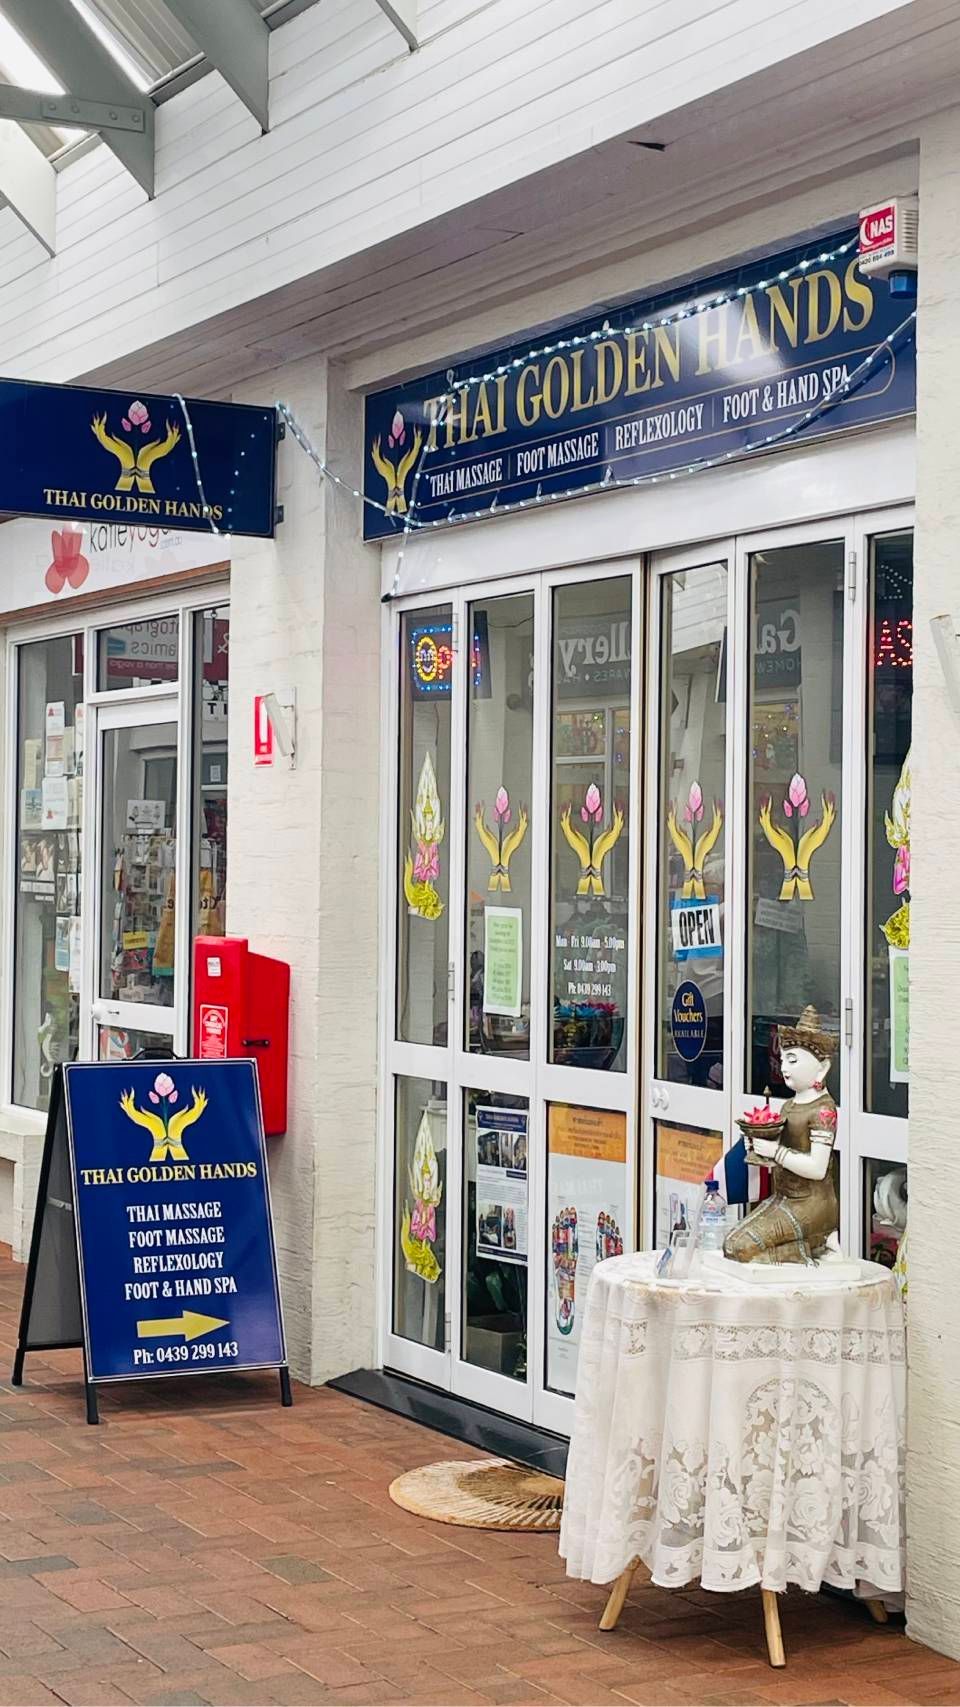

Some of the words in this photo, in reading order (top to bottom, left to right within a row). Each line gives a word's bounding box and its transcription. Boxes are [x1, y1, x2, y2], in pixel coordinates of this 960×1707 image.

[423, 374, 508, 453] THAI
[516, 324, 680, 427] GOLDEN
[693, 258, 875, 376] HANDS
[723, 388, 759, 423] FOOT
[762, 386, 774, 412] &
[777, 372, 819, 409] HAND
[822, 364, 850, 398] SPA
[615, 403, 704, 450] REFLEXOLOGY
[516, 449, 546, 476] FOOT
[547, 432, 599, 468] MASSAGE
[429, 469, 455, 497] THAI
[455, 458, 502, 492] MASSAGE
[43, 488, 87, 509] THAI
[90, 493, 161, 515] GOLDEN
[165, 502, 224, 521] HANDS
[679, 908, 715, 947] OPEN
[556, 935, 567, 947] Mon
[571, 935, 580, 948] Fri
[580, 935, 600, 949] 9.00am
[604, 936, 625, 951] 5.00pm
[563, 959, 572, 970] Sat
[573, 959, 593, 972] 9.00am
[596, 960, 616, 974] 3.00pm
[577, 982, 590, 995] 0439
[591, 983, 601, 996] 299
[602, 984, 611, 996] 143
[681, 991, 695, 1007] Gift
[673, 1009, 704, 1024] Vouchers
[81, 1168, 124, 1186] THAI
[127, 1164, 196, 1184] GOLDEN
[199, 1161, 257, 1180] HANDS
[126, 1204, 160, 1223] THAI
[163, 1201, 222, 1221] MASSAGE
[128, 1230, 163, 1248] FOOT
[166, 1227, 225, 1246] MASSAGE
[133, 1252, 224, 1274] REFLEXOLOGY
[125, 1282, 160, 1300] FOOT
[162, 1281, 173, 1297] &
[175, 1278, 212, 1296] HAND
[214, 1276, 238, 1294] SPA
[133, 1348, 155, 1365] Ph:
[156, 1345, 189, 1363] 0439
[191, 1343, 217, 1360] 299
[218, 1341, 239, 1358] 143
